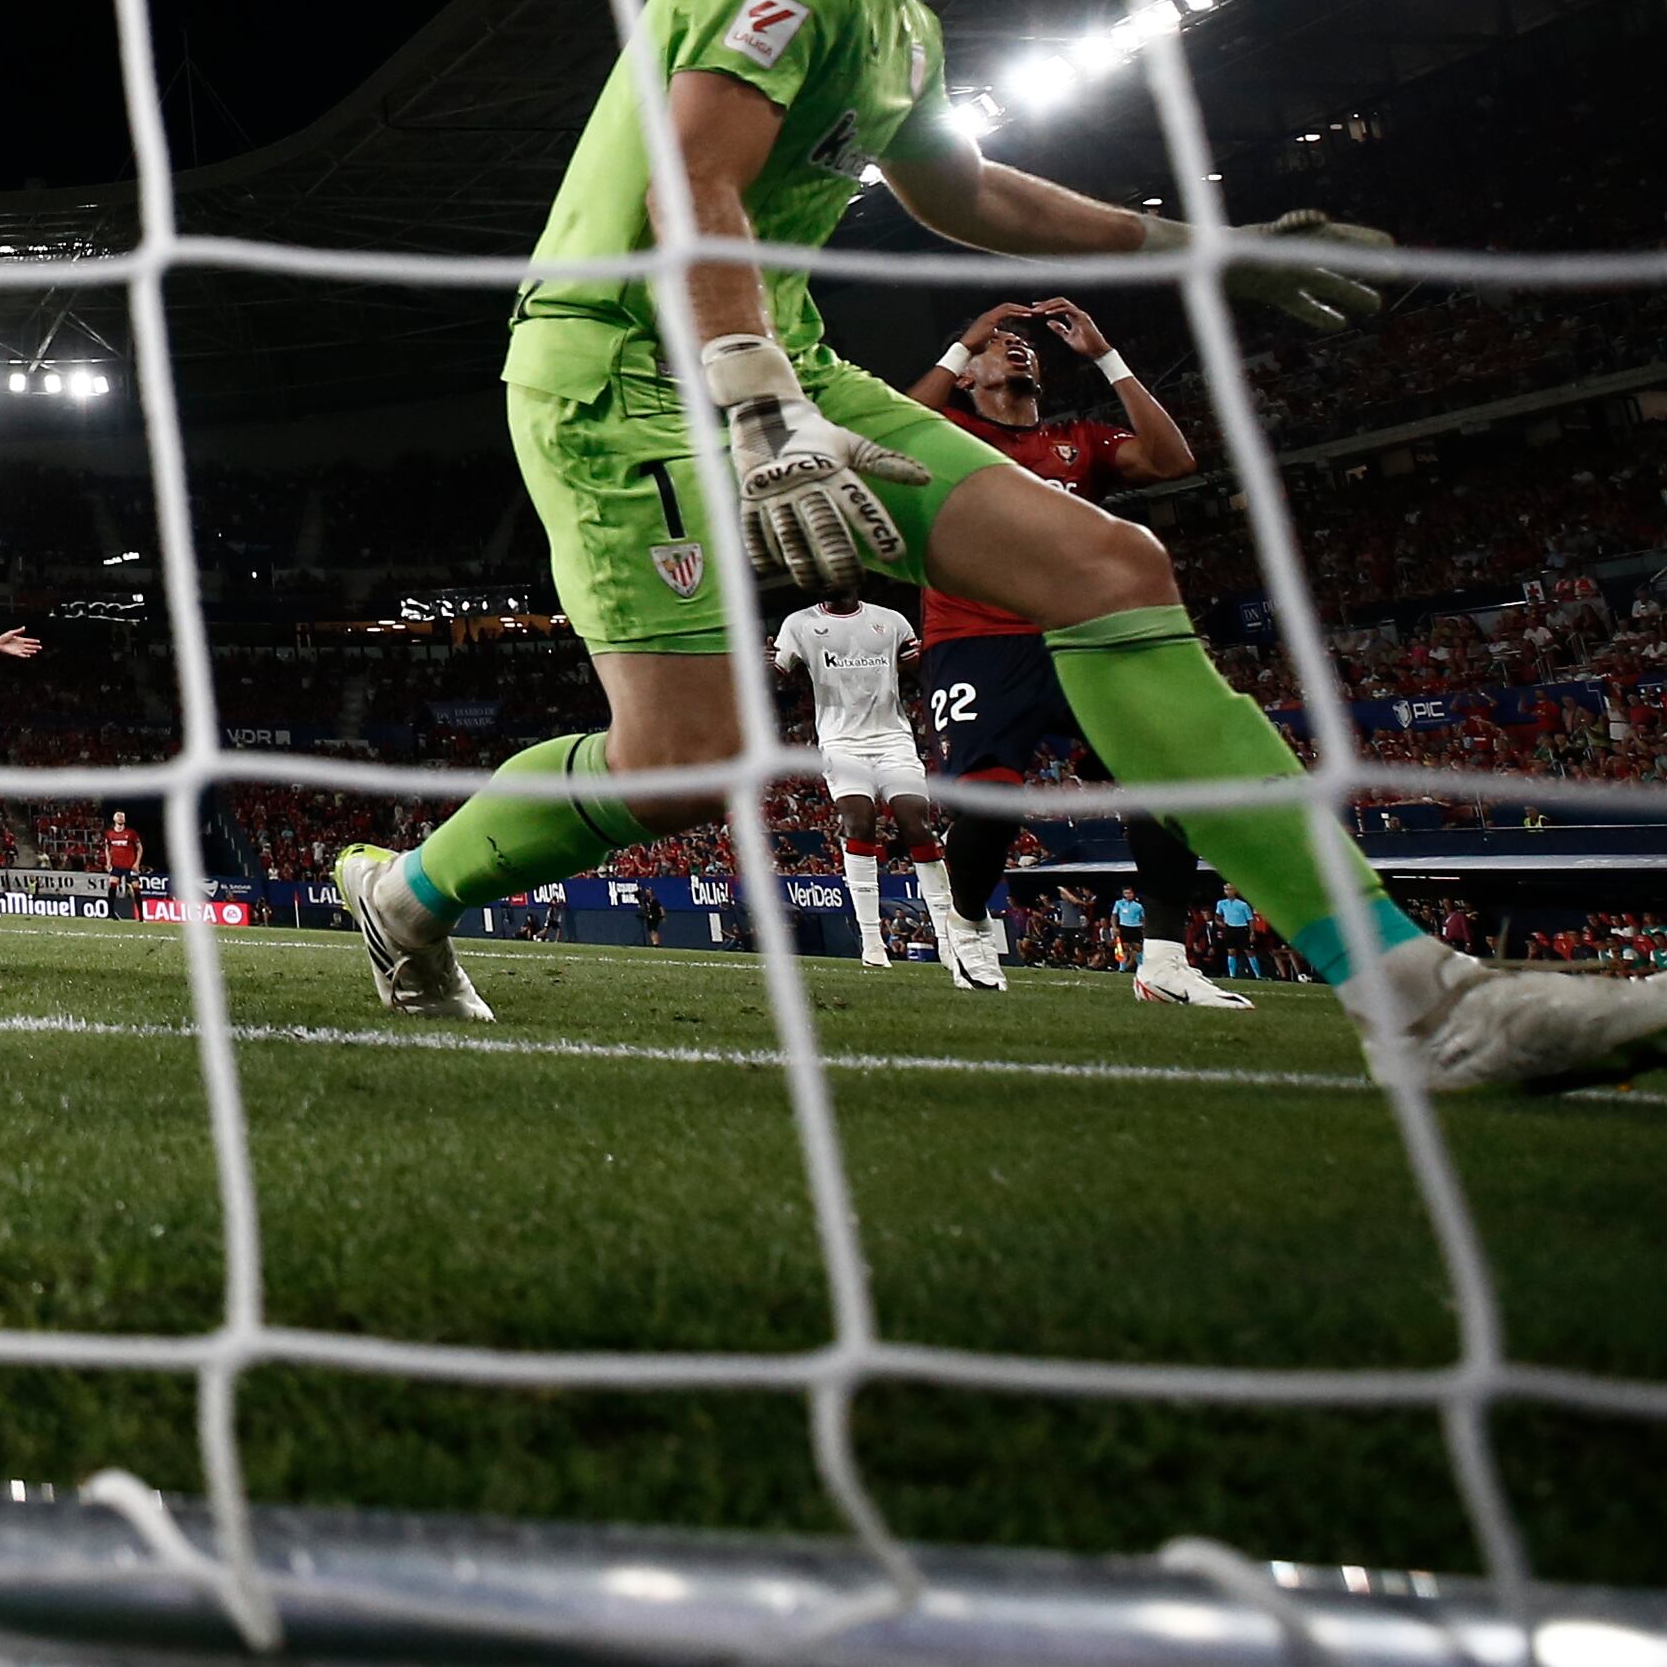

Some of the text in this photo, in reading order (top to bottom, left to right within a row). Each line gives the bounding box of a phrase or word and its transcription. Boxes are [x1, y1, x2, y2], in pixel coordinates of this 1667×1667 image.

[745, 453, 834, 496] reusch
[639, 461, 685, 539] 1
[841, 483, 898, 554] reusch
[824, 651, 890, 668] Kutxabank
[931, 681, 978, 732] 22
[1412, 700, 1446, 719] PIC
[226, 728, 273, 745] VDR
